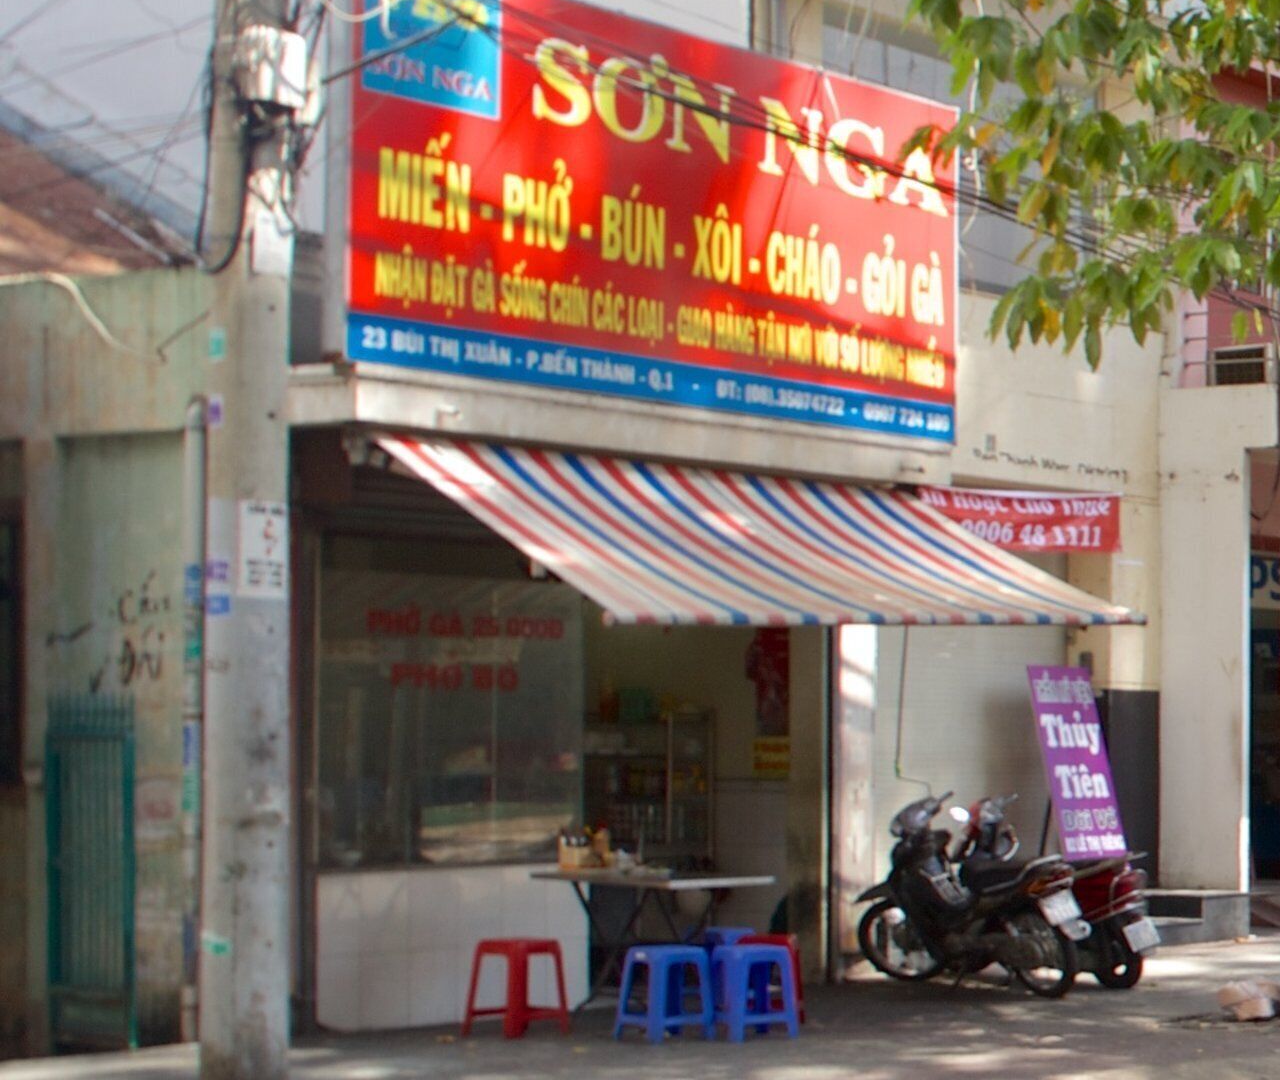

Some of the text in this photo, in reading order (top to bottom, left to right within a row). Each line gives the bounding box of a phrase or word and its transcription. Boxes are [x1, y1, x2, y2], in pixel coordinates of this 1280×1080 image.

[432, 67, 494, 102] NGA
[757, 96, 949, 217] NGA
[379, 132, 945, 326] MIẾN PHỞ BÚN XÔI CHÁO GỎI GÀ
[362, 325, 386, 349] 23
[1054, 763, 1110, 799] Tiên
